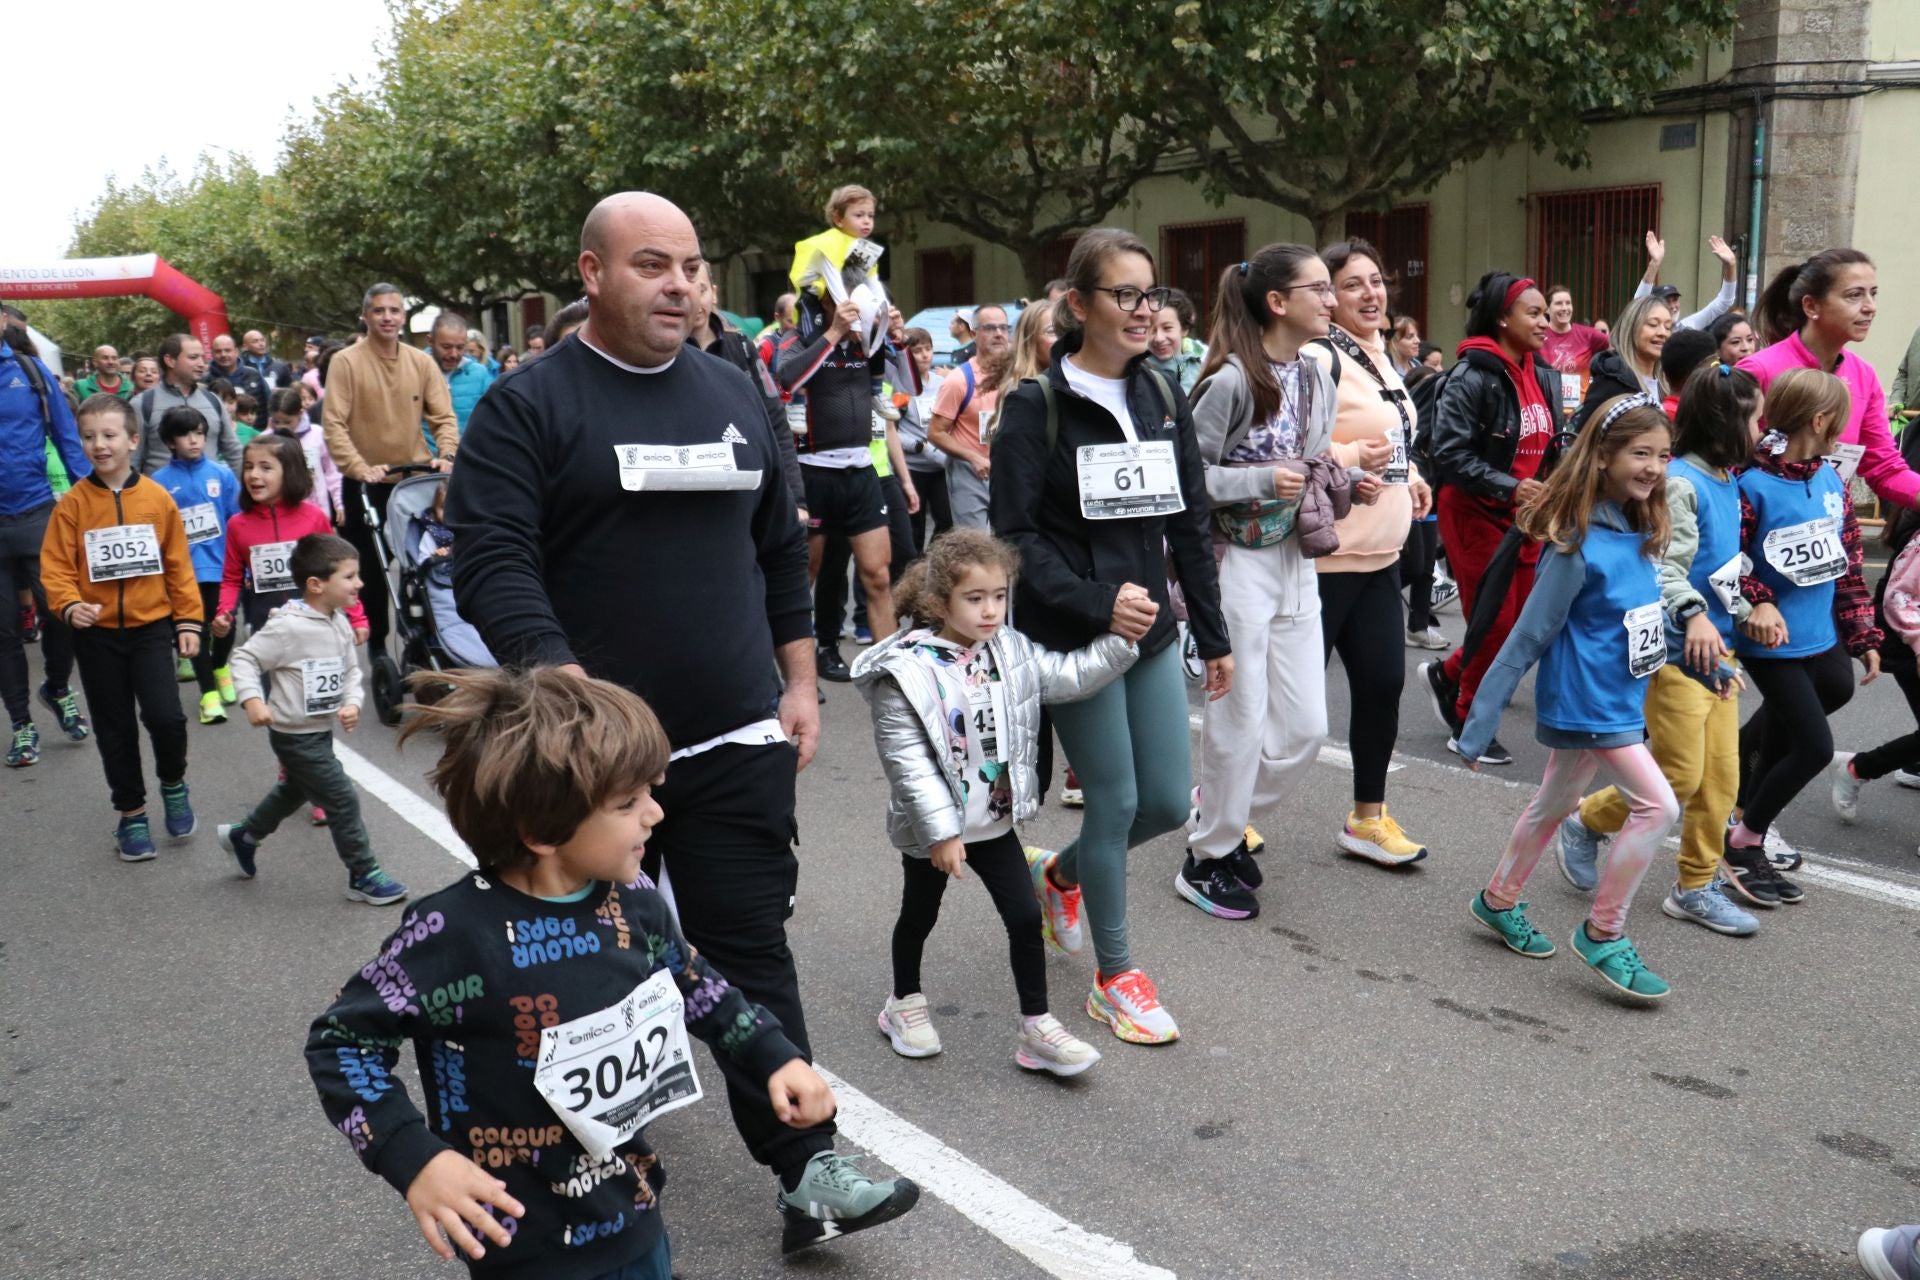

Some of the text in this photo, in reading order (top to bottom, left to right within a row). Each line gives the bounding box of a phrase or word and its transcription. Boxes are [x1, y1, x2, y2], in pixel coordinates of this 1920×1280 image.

[41, 269, 58, 278] DE
[1114, 466, 1145, 491] 61
[99, 541, 149, 562] 3052
[1780, 537, 1832, 568] 2501
[505, 916, 577, 944] POPS!
[511, 931, 600, 969] COLOUR
[562, 1025, 668, 1113] 3042
[469, 1125, 563, 1147] COLOUR
[473, 1146, 540, 1168] POPS!
